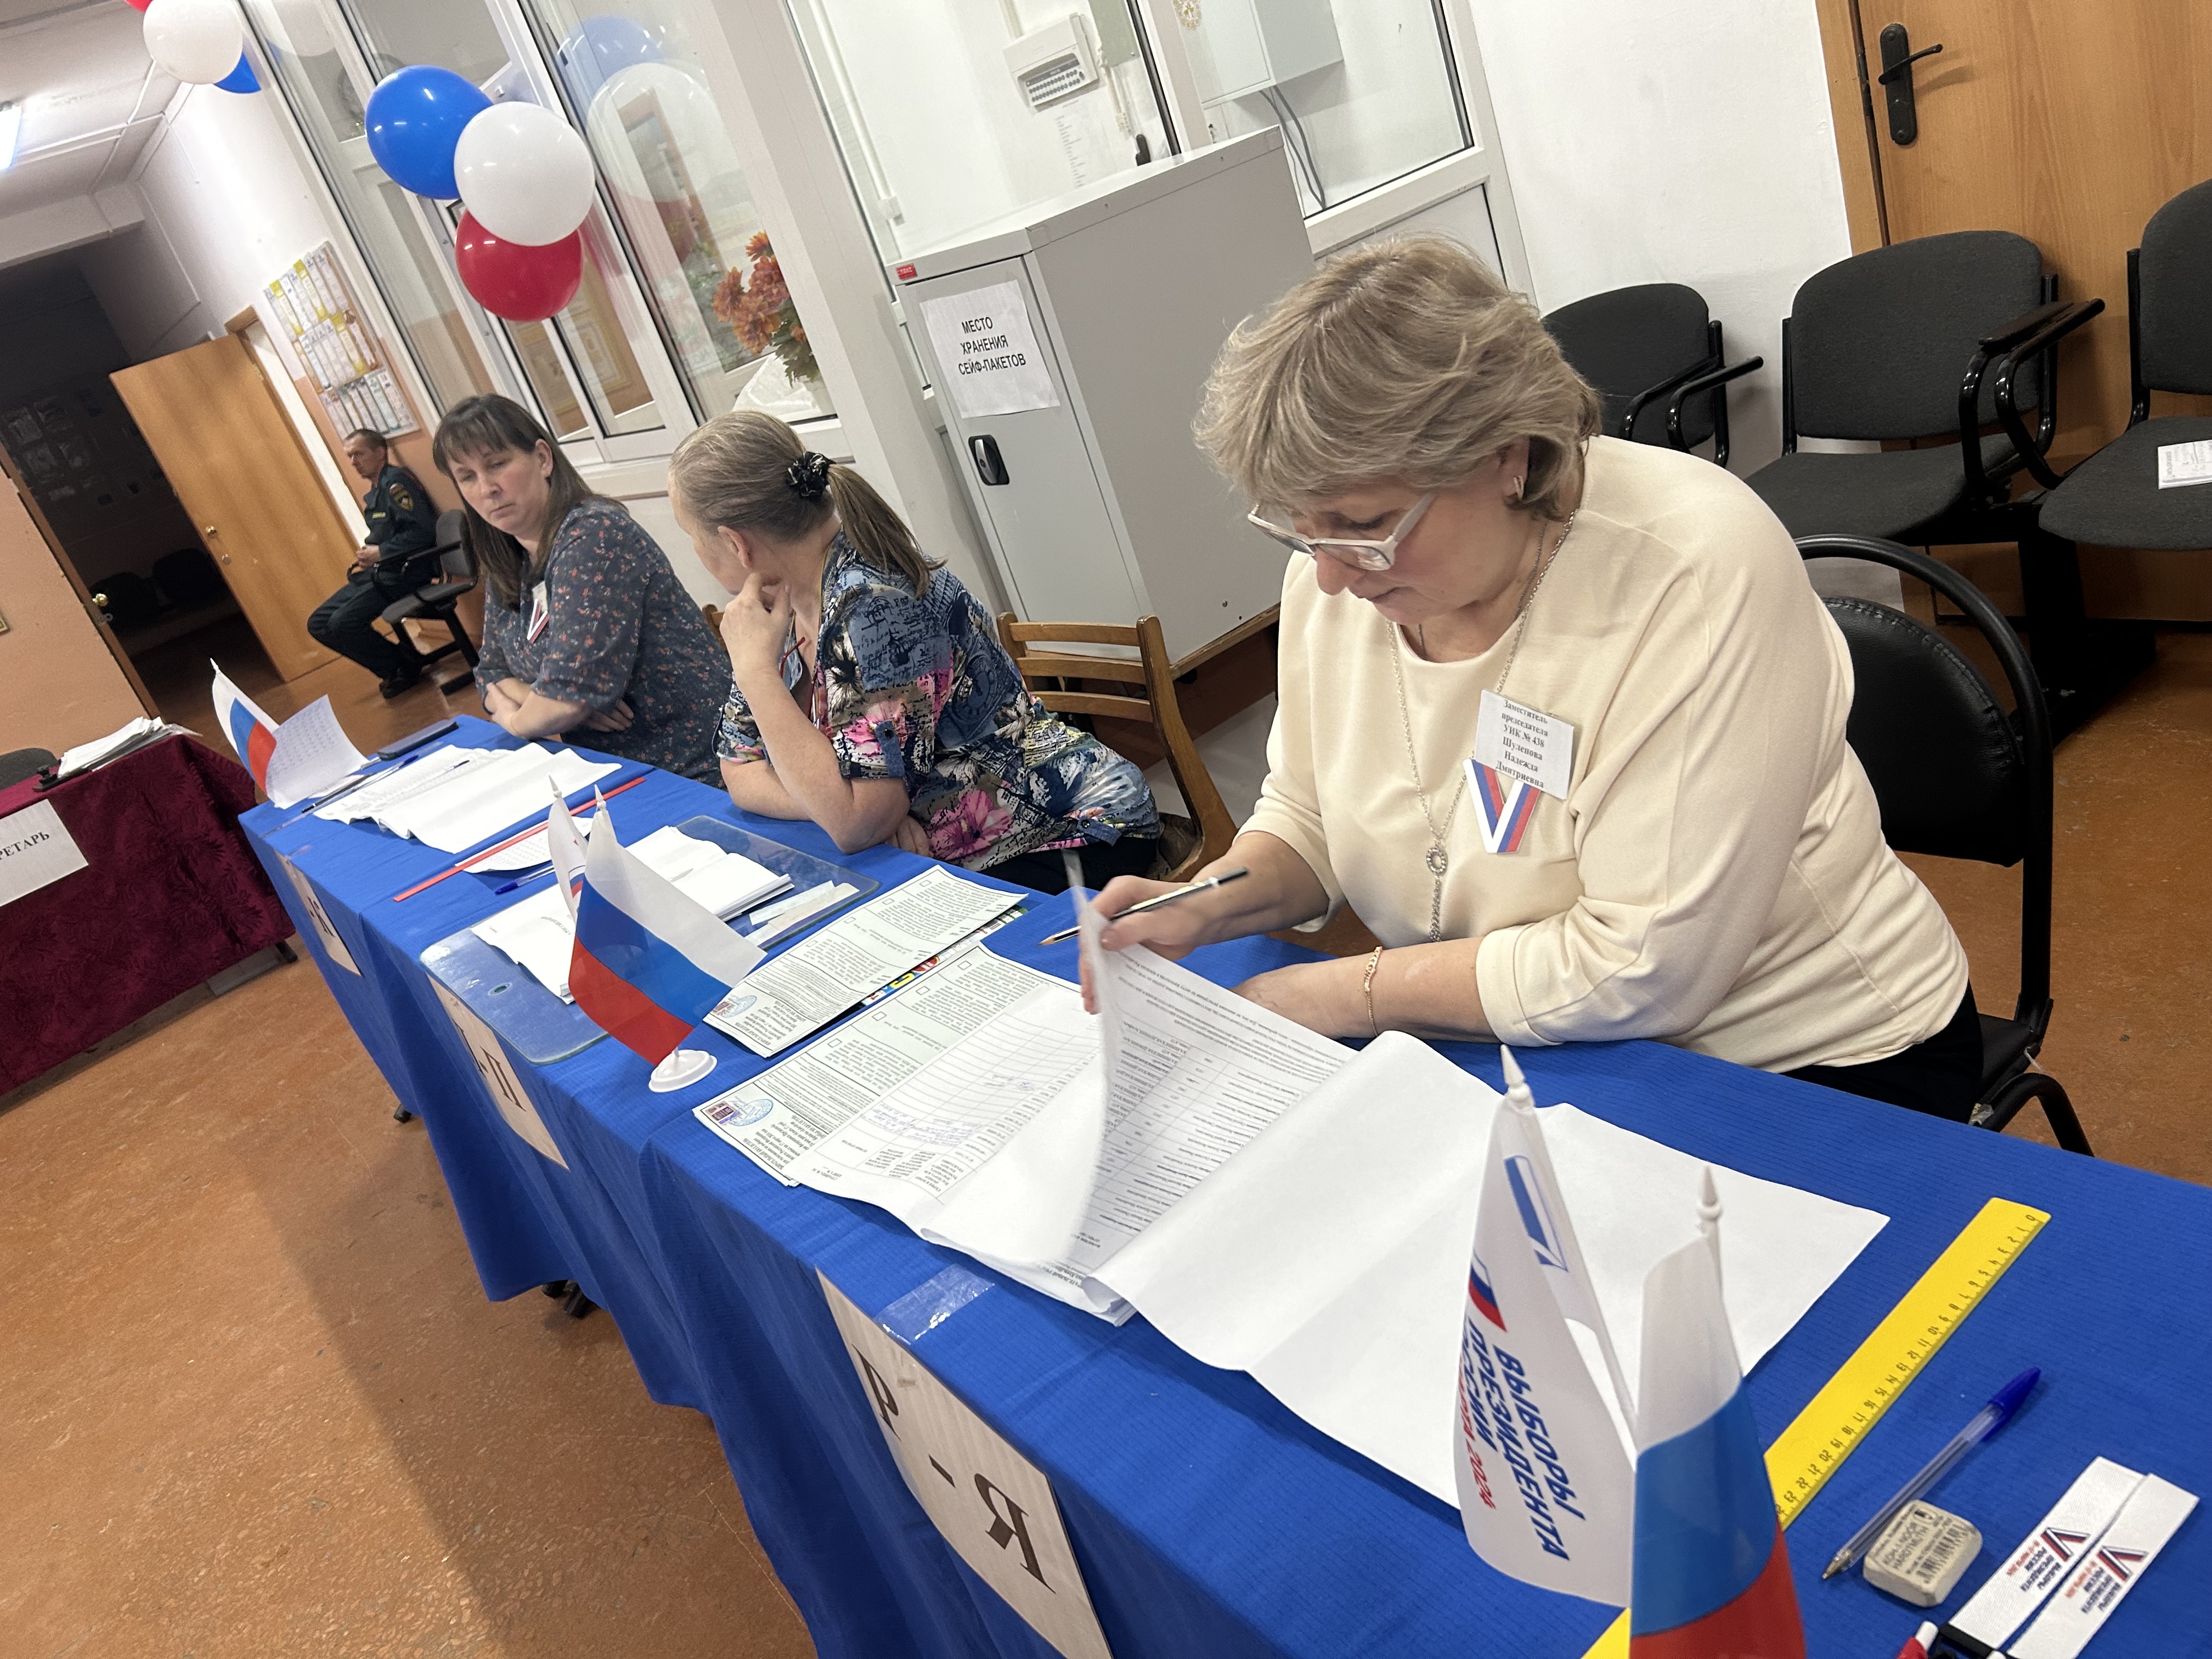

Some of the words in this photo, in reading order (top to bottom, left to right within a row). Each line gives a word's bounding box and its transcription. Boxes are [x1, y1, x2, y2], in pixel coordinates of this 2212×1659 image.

[961, 317, 993, 334] МЕСТО
[960, 335, 1008, 355] ХРАНЕНИЯ
[958, 353, 1026, 375] СЕЙФ-ПАКЕТОВ
[1503, 699, 1548, 724] Заместитель
[1502, 713, 1548, 737] председателя
[1503, 724, 1521, 738] УИК
[1532, 735, 1545, 748] 438
[1503, 737, 1543, 761] Шулепова
[1504, 751, 1538, 772] Надежда
[1496, 760, 1544, 788] Дмитриевна
[1927, 1326, 1939, 1335] 10
[1917, 1338, 1929, 1347] 11
[1906, 1350, 1919, 1359] 12
[1895, 1362, 1908, 1372] 13
[1463, 1316, 1498, 1452] ССИИ
[1885, 1374, 1898, 1384] 14
[1874, 1387, 1887, 1397] 15
[1863, 1400, 1876, 1409] 16
[1853, 1412, 1865, 1422] 17
[1492, 1343, 1587, 1521] ВЫБОРЫ
[1842, 1424, 1854, 1435] 18
[1468, 1316, 1571, 1561] ПРЕЗИДЕНТА
[1830, 1438, 1843, 1448] 19
[1819, 1449, 1832, 1462] 20
[1465, 1437, 1497, 1510] 2024
[1807, 1463, 1821, 1475] 21
[1796, 1476, 1809, 1489] 22
[1784, 1490, 1797, 1503] 23
